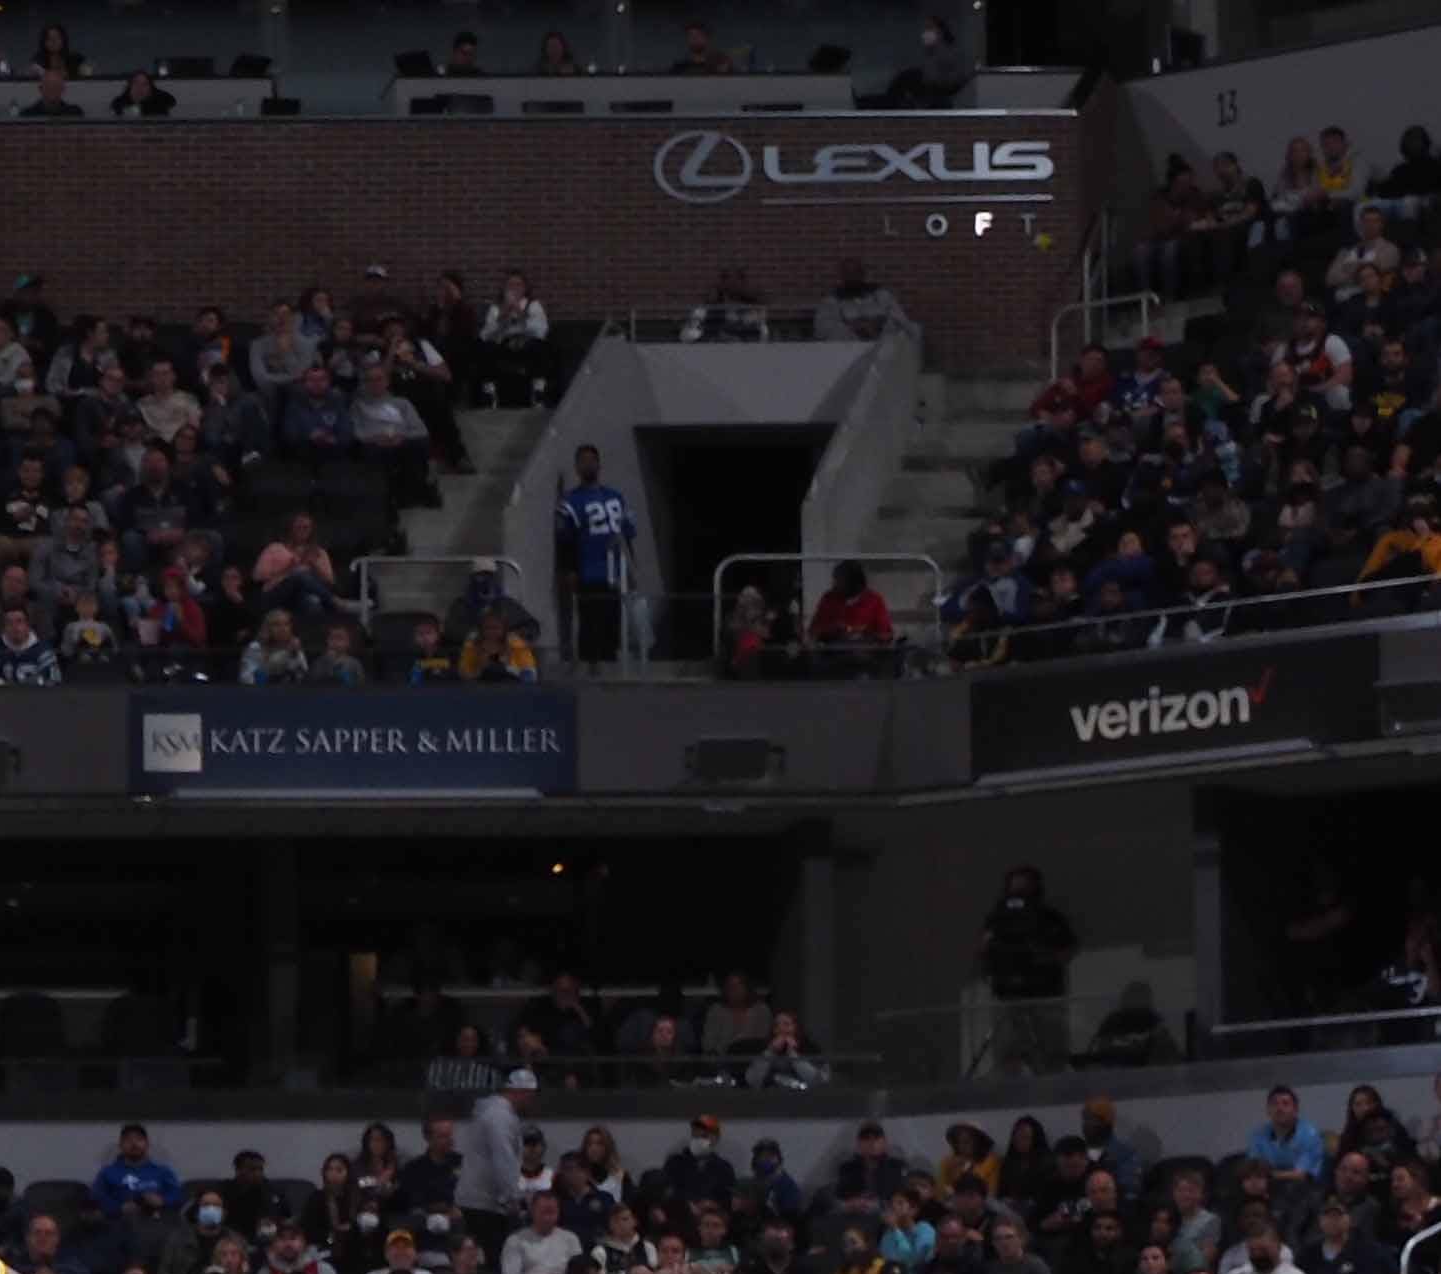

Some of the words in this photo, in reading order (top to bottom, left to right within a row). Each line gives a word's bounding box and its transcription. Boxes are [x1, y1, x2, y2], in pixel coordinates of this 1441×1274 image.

[763, 140, 1055, 184] LEXUS
[883, 210, 1038, 238] LOFT
[1068, 684, 1251, 743] verizon
[210, 727, 285, 754] KATZ
[293, 727, 408, 754] SAPPER
[417, 728, 439, 753] &
[445, 727, 561, 754] MILLER
